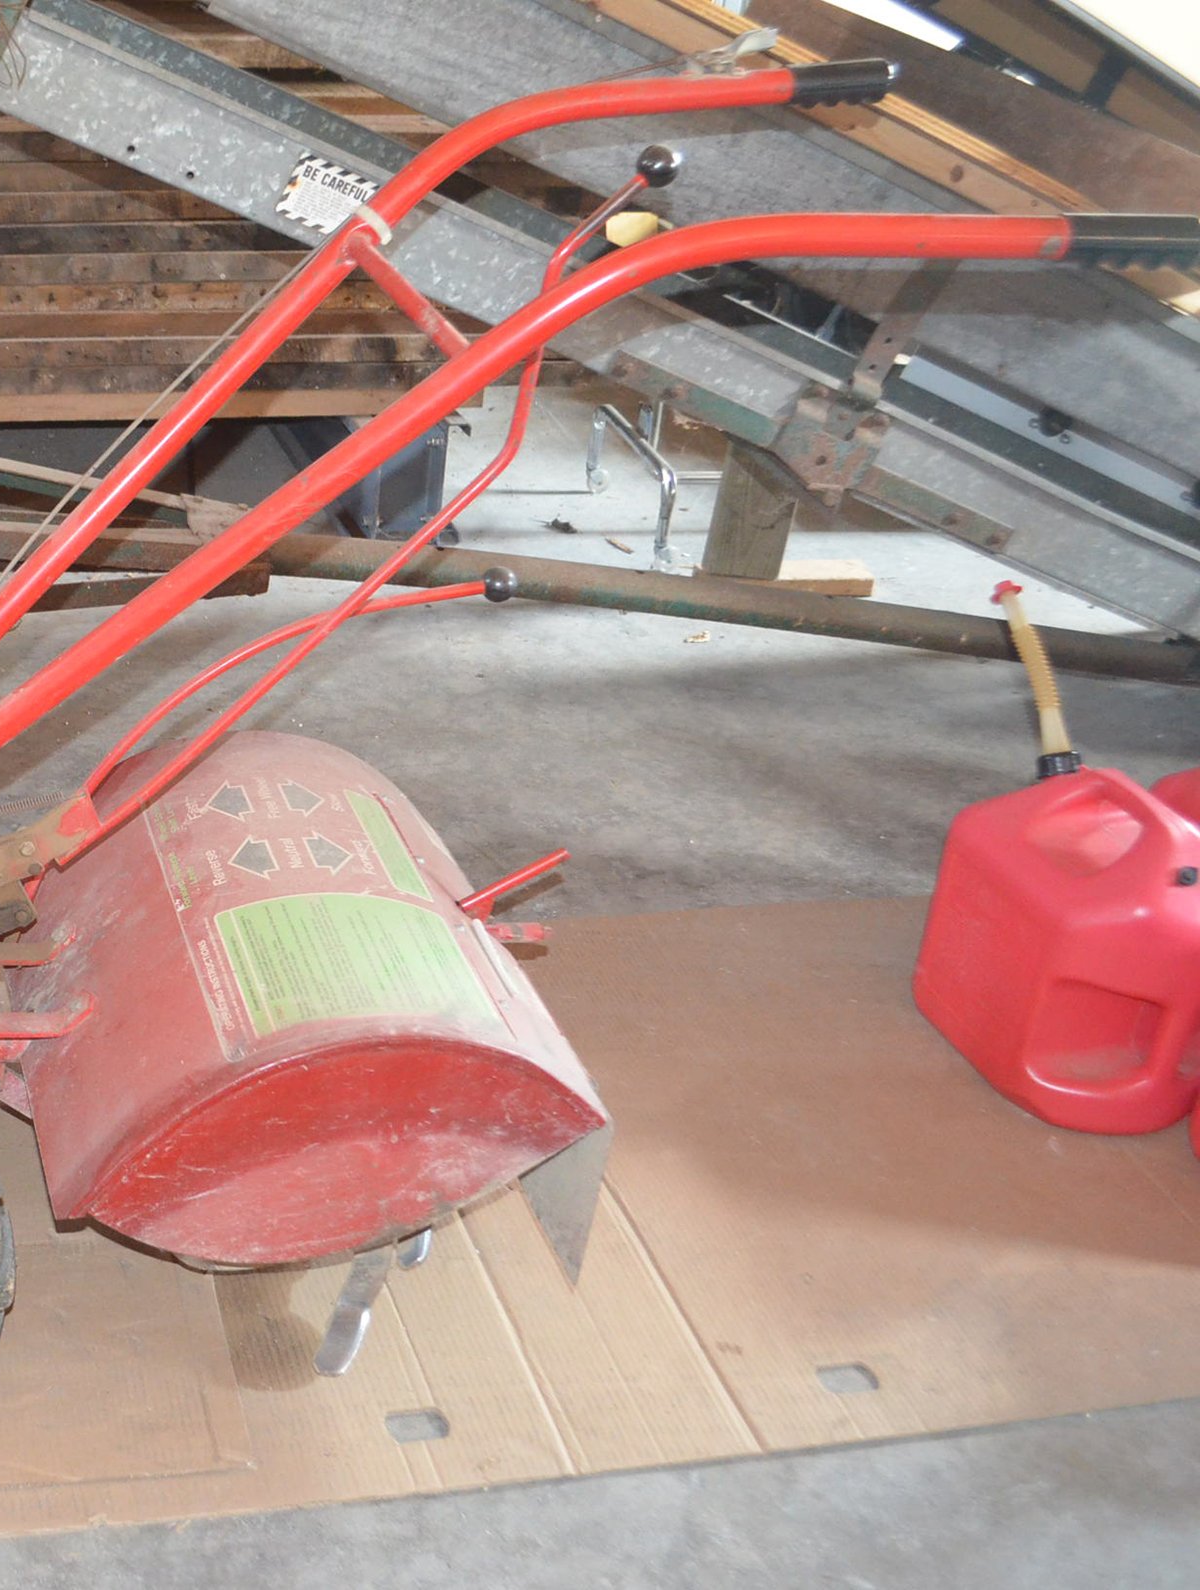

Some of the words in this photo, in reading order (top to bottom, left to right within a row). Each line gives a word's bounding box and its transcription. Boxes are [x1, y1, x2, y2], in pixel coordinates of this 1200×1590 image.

[303, 165, 320, 181] BE
[321, 173, 368, 203] CAREFUL
[186, 799, 202, 821] Fast
[205, 849, 227, 886] Reverse
[279, 837, 304, 868] Neutral
[197, 939, 223, 990] INSTRUCTIONS
[212, 989, 236, 1032] OPERATING
